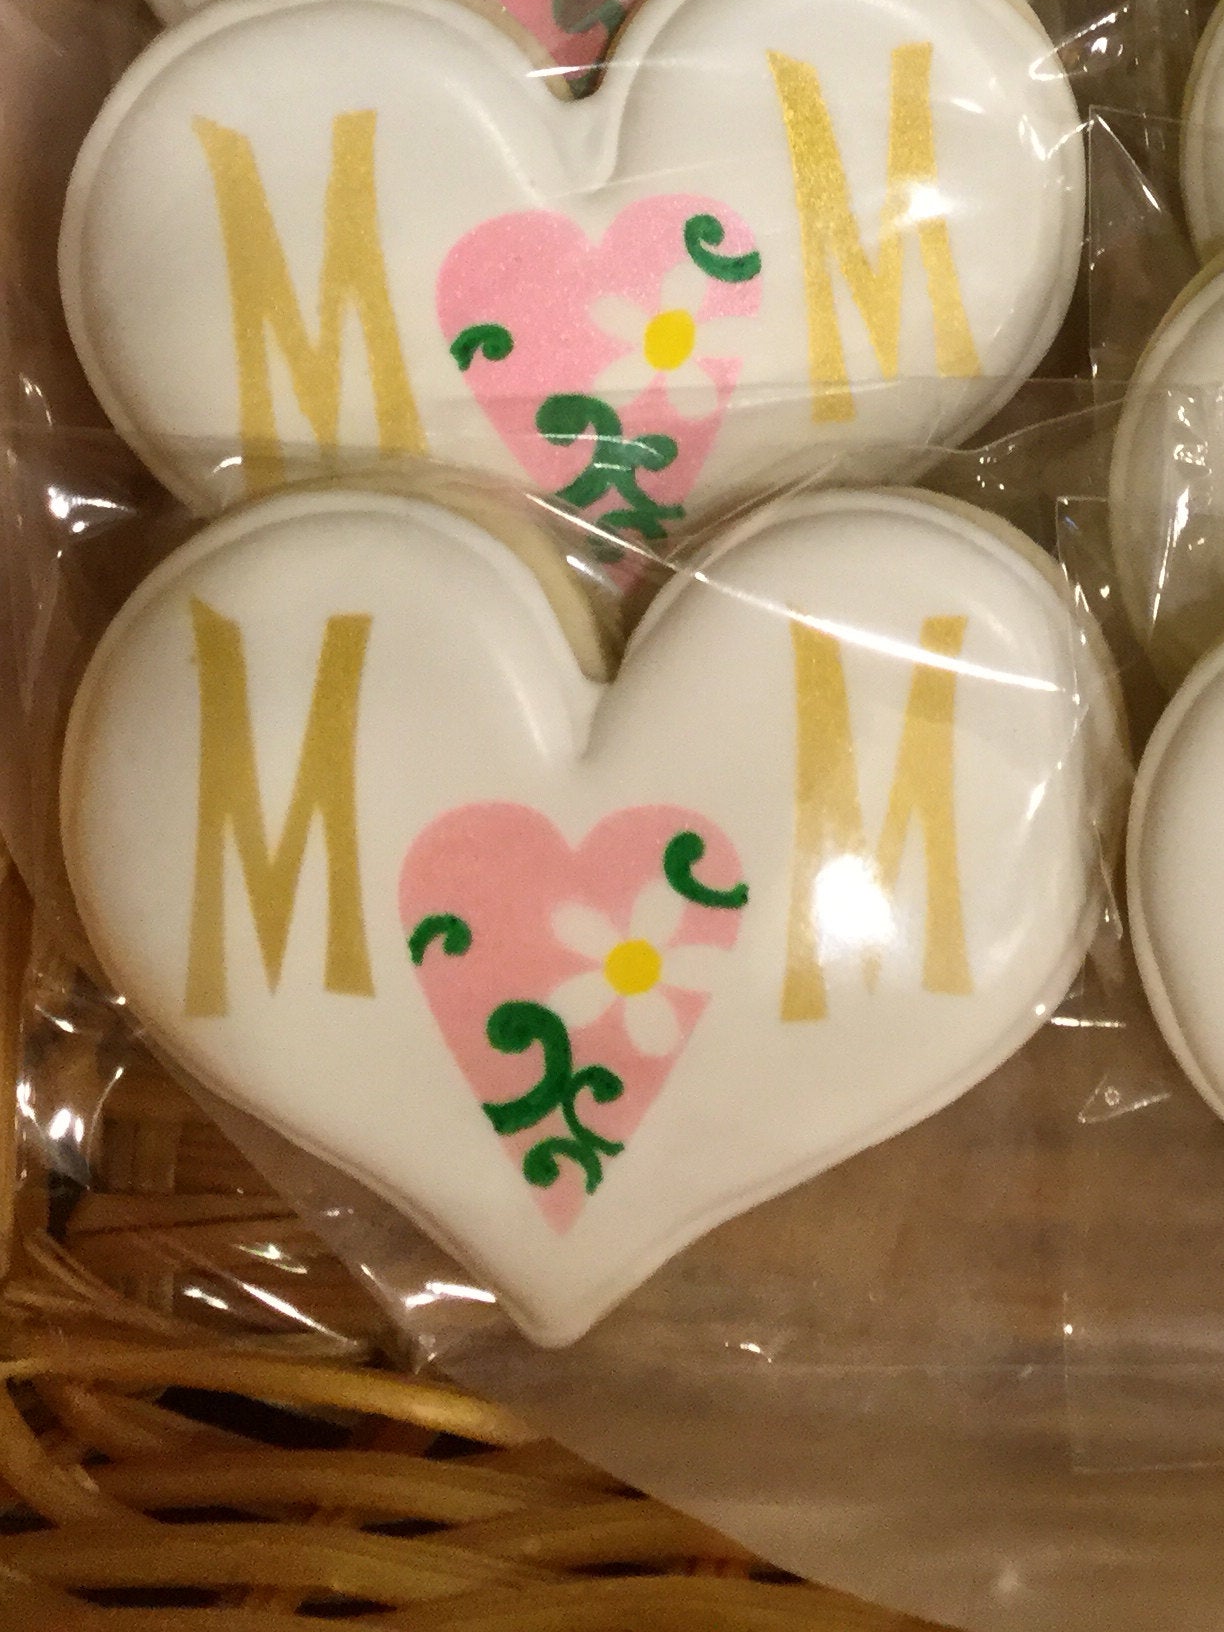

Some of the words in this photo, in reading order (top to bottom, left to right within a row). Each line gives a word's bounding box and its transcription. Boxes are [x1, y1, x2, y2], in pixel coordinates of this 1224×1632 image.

[190, 108, 430, 493] M
[765, 40, 982, 422] M
[185, 597, 375, 1017] M
[780, 604, 973, 1023] M
